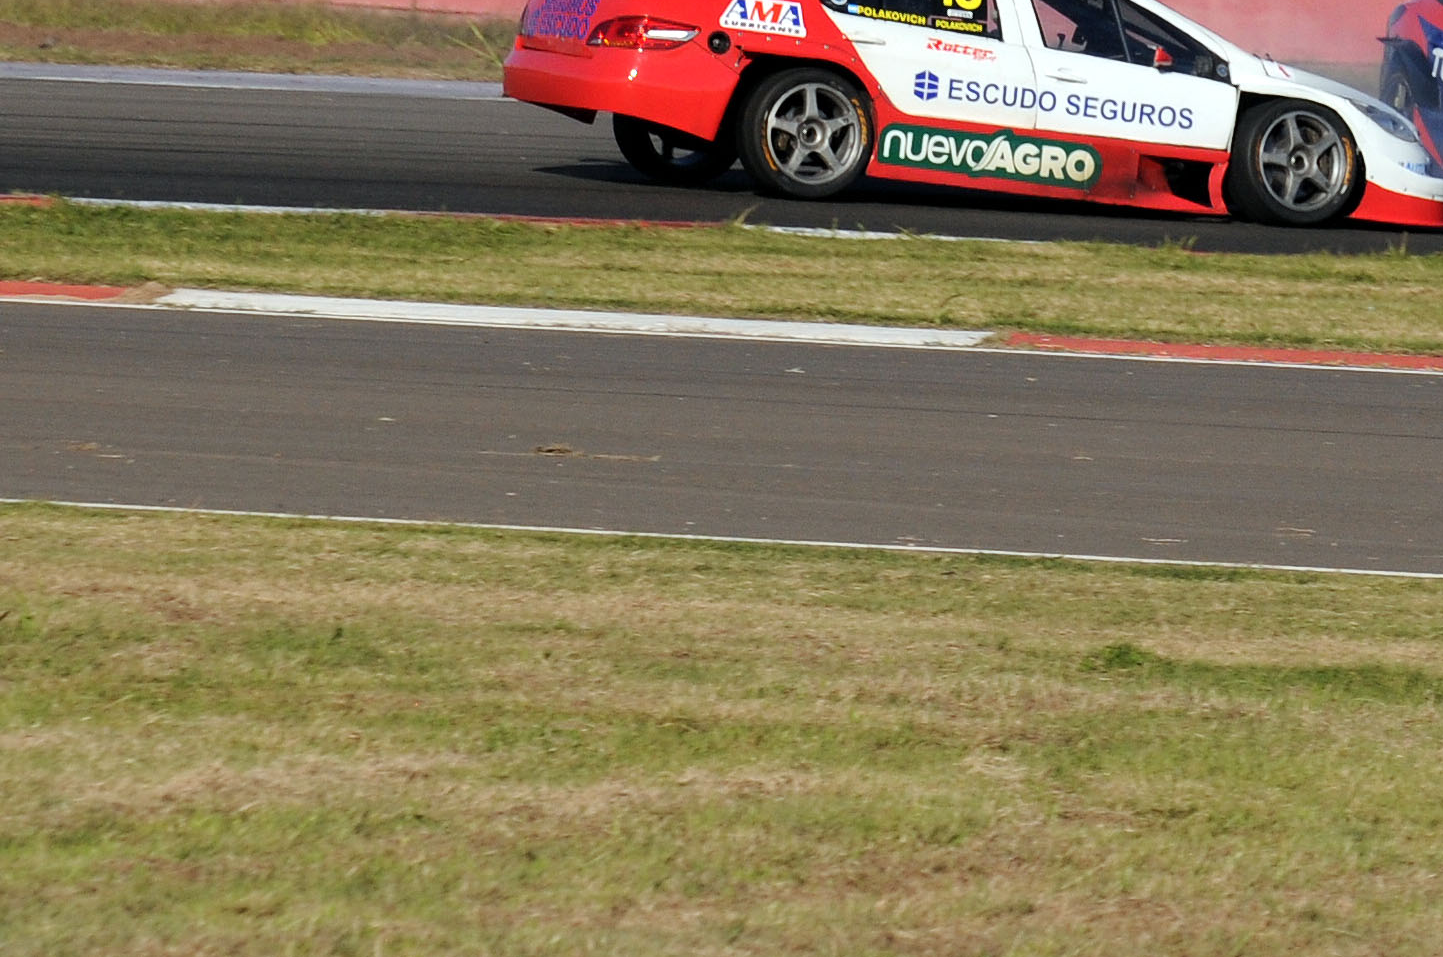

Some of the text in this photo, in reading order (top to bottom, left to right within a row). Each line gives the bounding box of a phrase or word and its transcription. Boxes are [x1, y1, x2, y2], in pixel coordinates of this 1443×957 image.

[857, 5, 926, 25] POLAKOVICH
[724, 19, 801, 34] LUBRICANTS
[935, 19, 983, 33] POLAKOVICH
[948, 78, 1194, 130] ESCUDO SEGUROS
